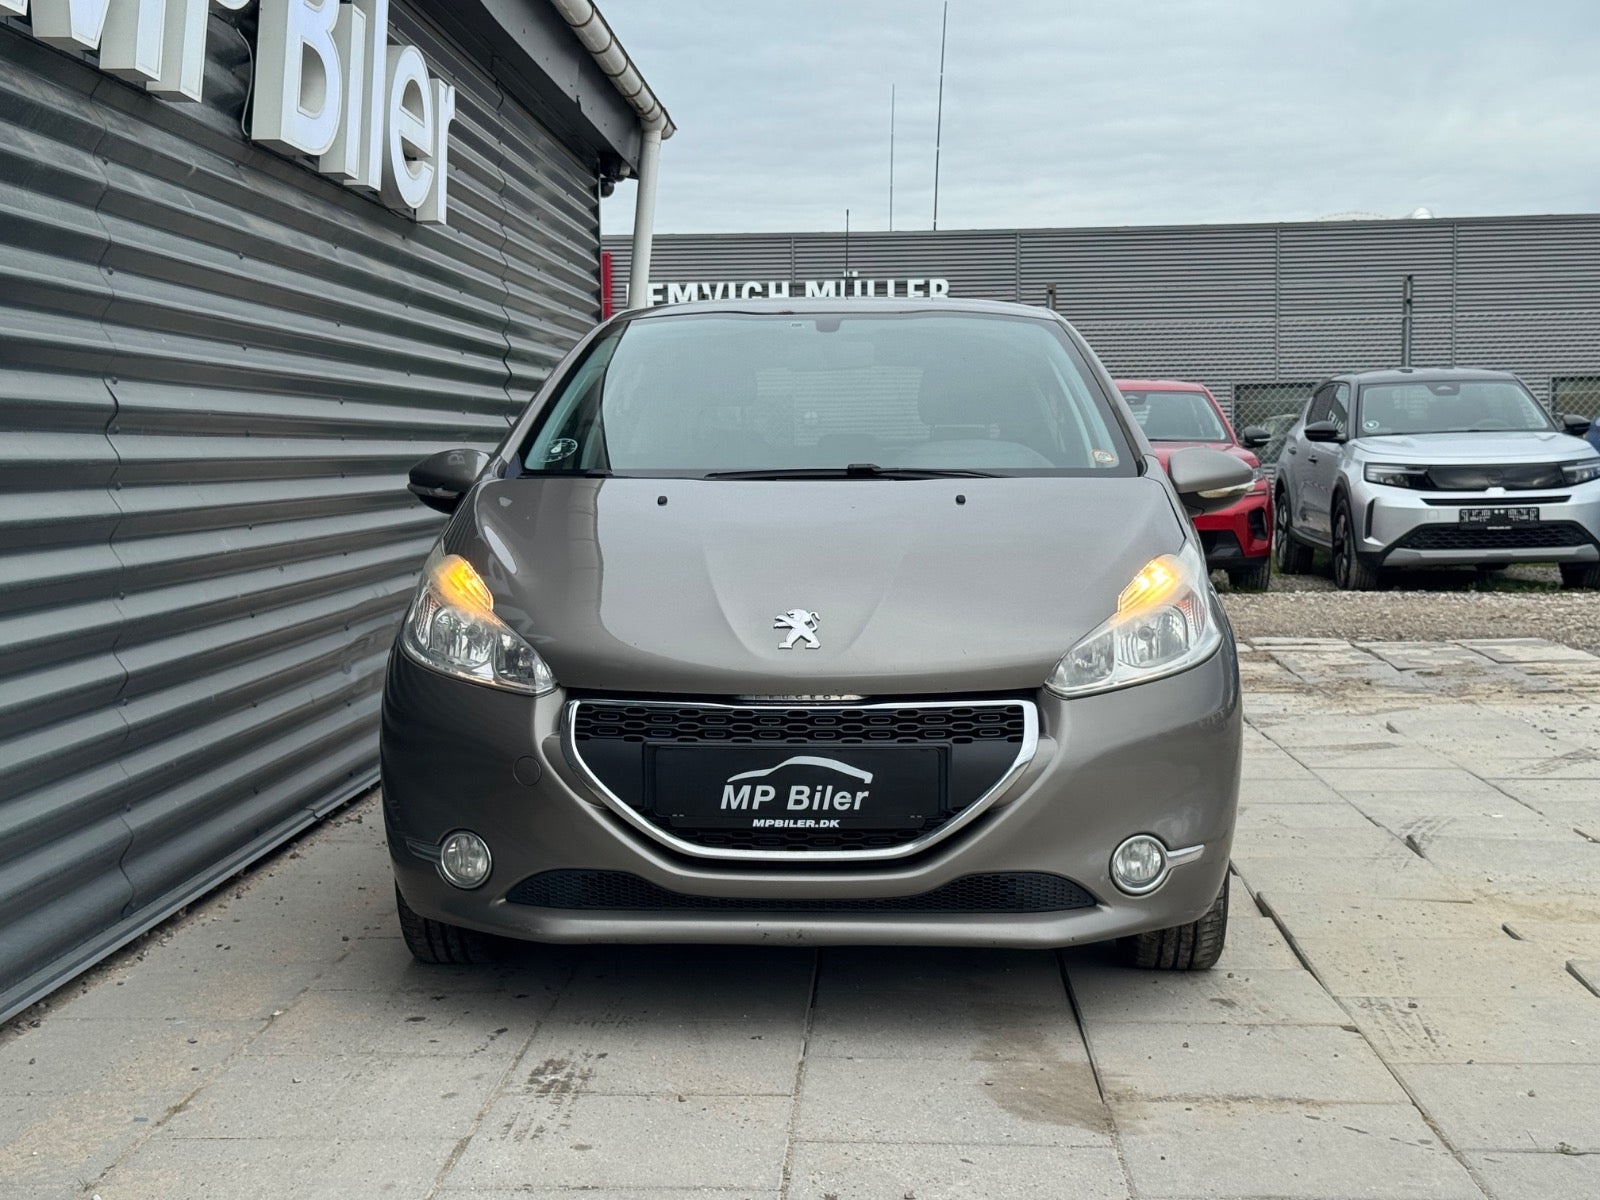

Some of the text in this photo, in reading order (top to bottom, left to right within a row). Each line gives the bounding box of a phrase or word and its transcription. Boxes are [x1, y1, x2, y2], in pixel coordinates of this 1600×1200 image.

[720, 784, 870, 811] MP Biler
[752, 818, 841, 828] MPBILER.DK
